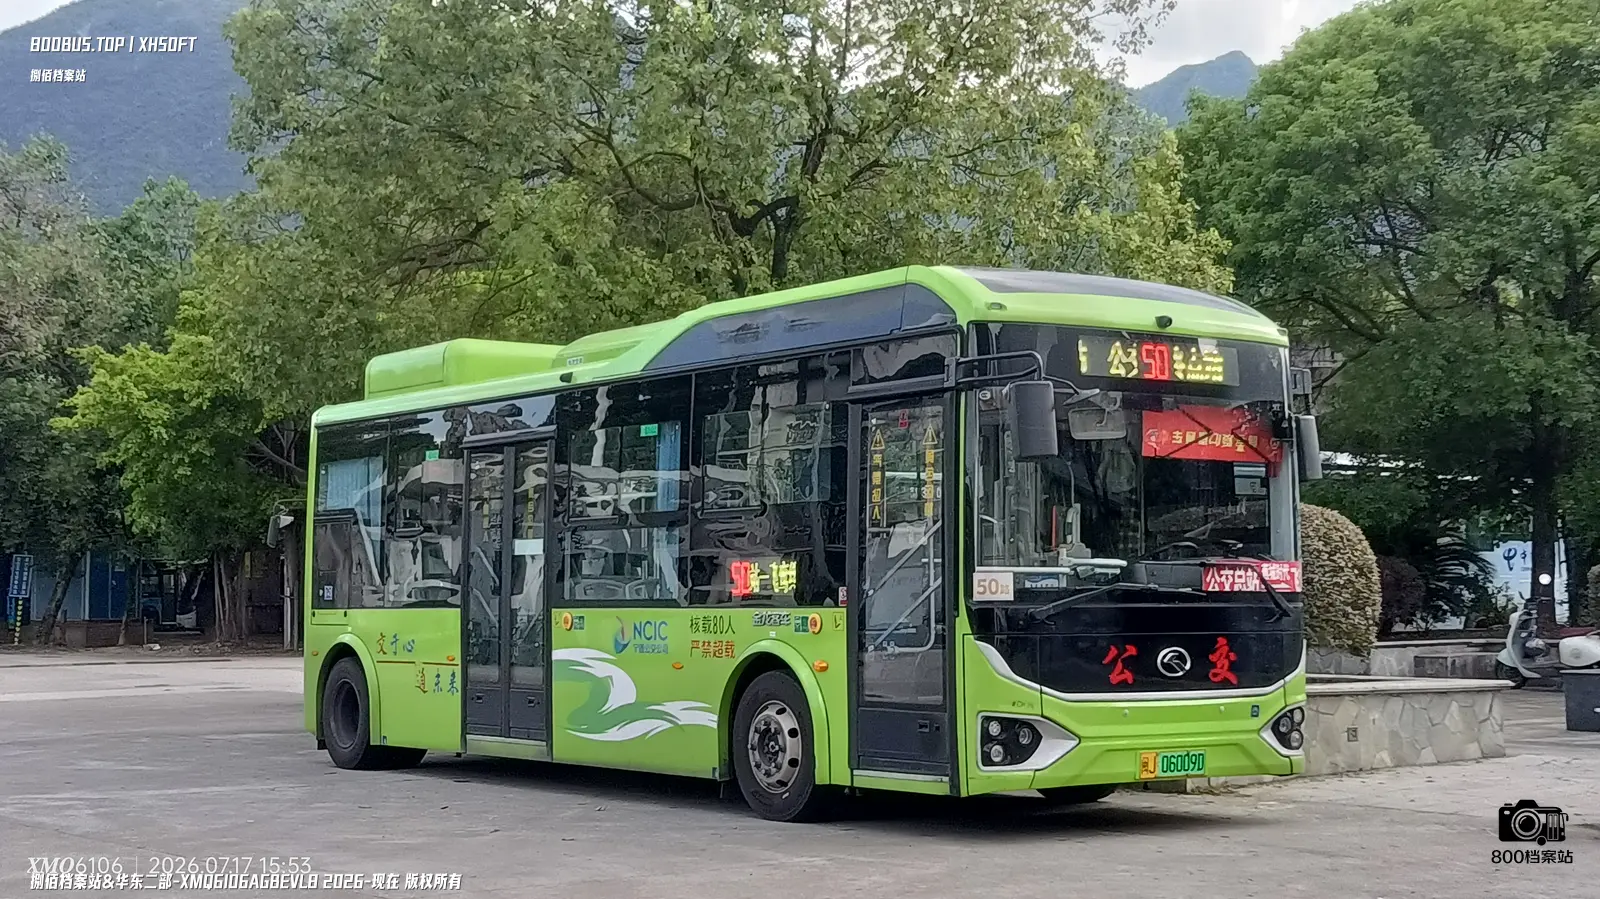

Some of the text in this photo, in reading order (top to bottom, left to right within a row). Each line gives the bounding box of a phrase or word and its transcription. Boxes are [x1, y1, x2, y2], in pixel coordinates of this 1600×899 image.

[633, 620, 669, 641] NCIC
[689, 615, 736, 635] 核载80人
[689, 639, 736, 659] 严禁超载
[1102, 644, 1139, 685] 公
